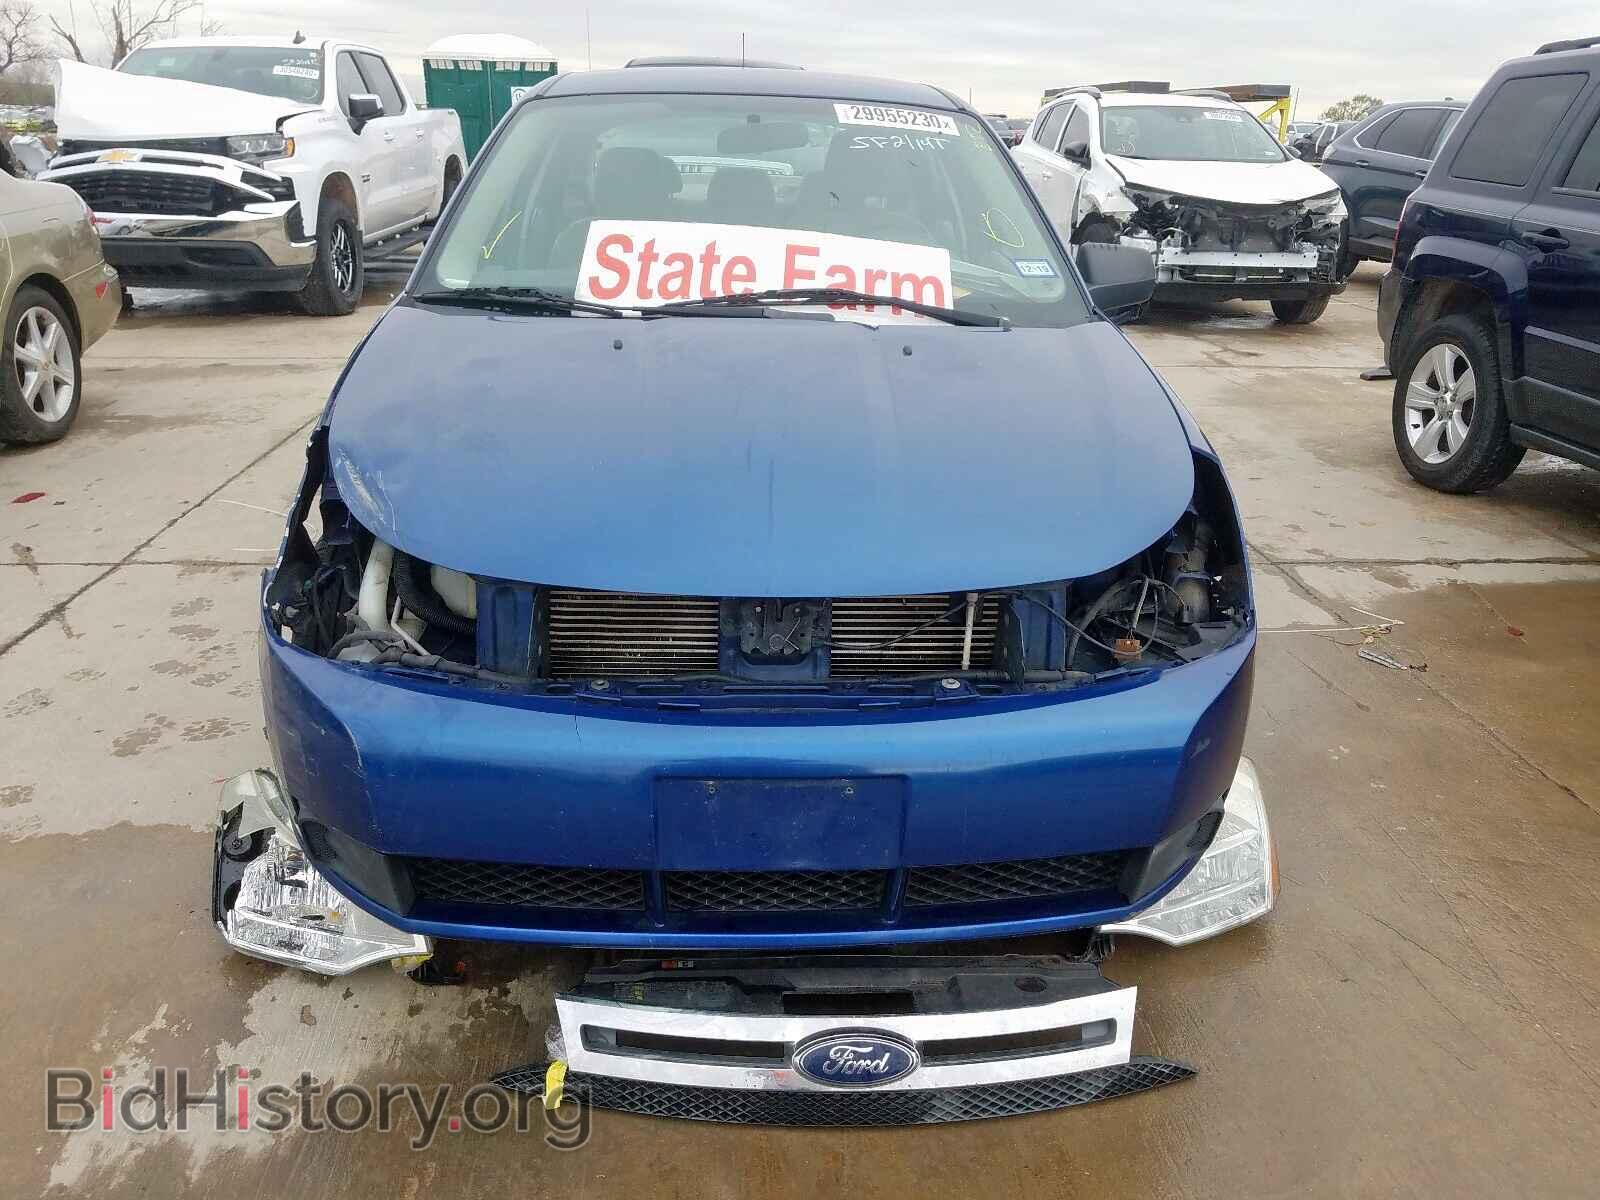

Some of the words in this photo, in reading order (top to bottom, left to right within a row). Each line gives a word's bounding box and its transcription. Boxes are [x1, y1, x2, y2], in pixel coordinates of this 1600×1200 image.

[850, 105, 943, 129] 29955230
[588, 233, 757, 301] State
[783, 243, 945, 319] Farm
[822, 1045, 890, 1075] Ford
